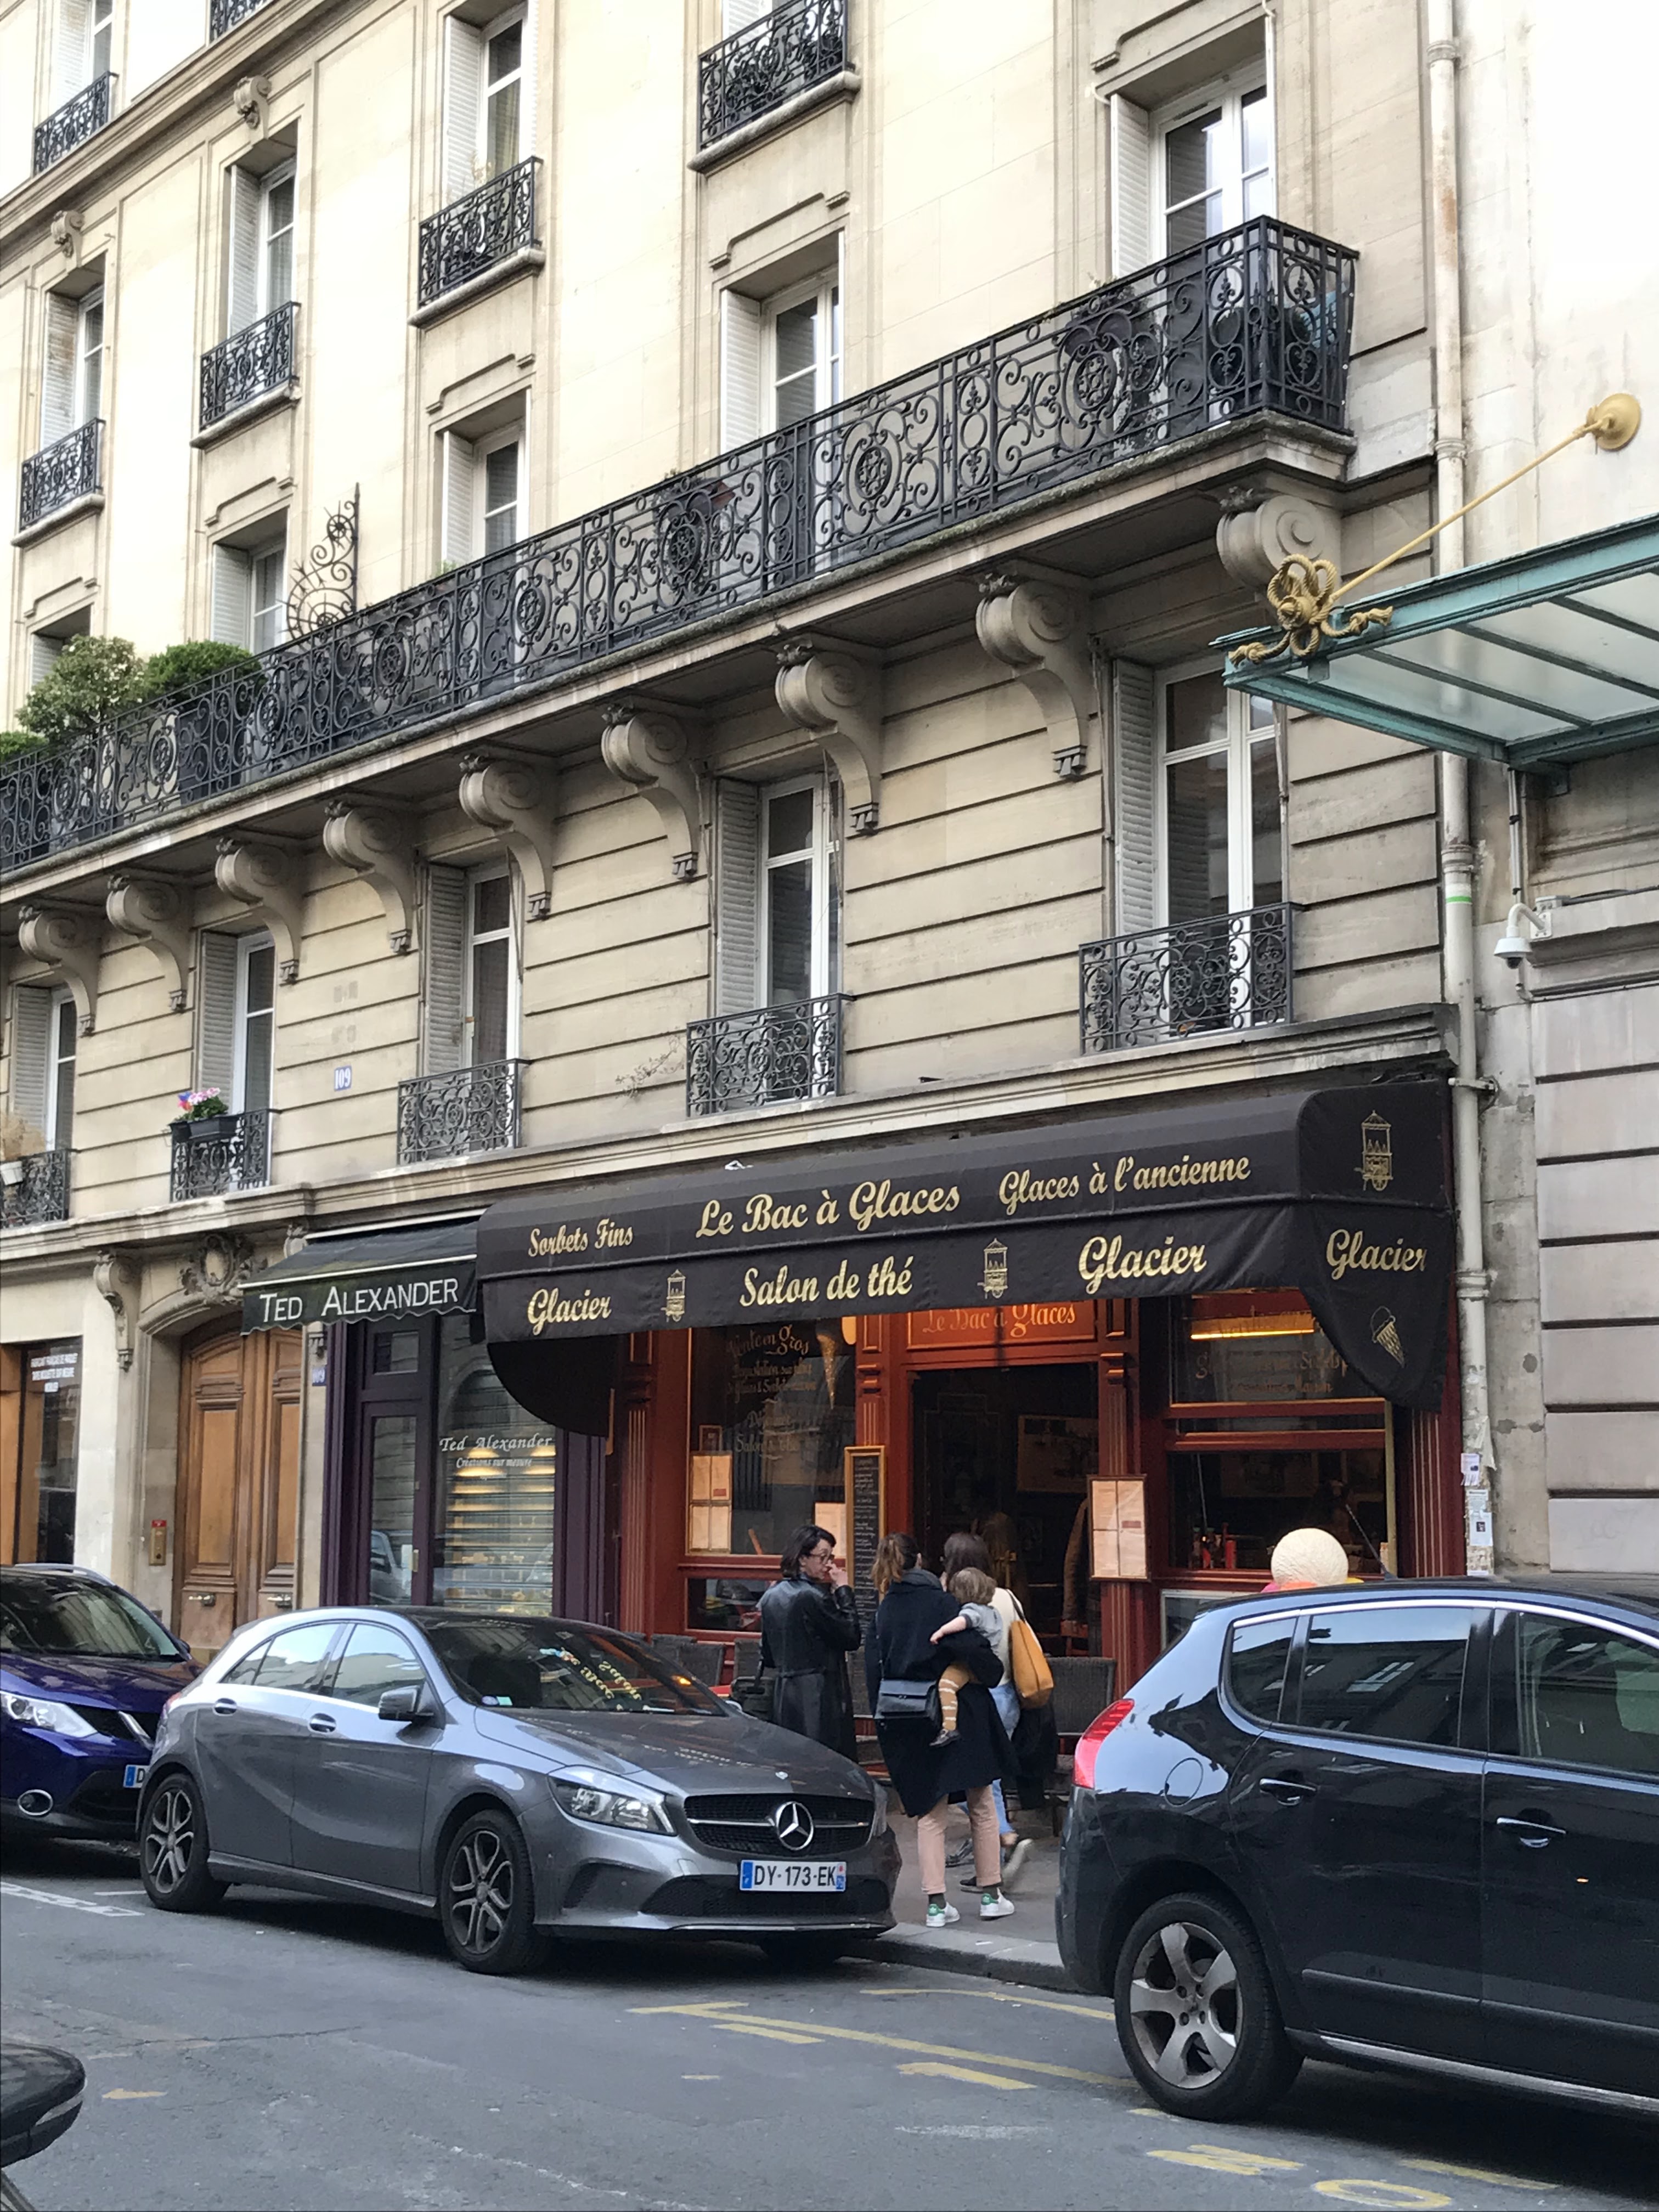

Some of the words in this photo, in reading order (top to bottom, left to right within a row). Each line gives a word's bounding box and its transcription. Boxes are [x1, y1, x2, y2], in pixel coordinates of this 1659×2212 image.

[335, 1068, 352, 1090] 109
[696, 1200, 734, 1238] Le
[742, 1194, 808, 1232] Bac
[816, 1189, 840, 1225] à
[849, 1179, 960, 1231] Glaces
[999, 1169, 1079, 1215] Glaces
[1089, 1162, 1108, 1194] à
[1114, 1155, 1251, 1192] l'ancienne
[528, 1224, 588, 1257] Sorbets
[594, 1218, 633, 1249] Fins
[1326, 1229, 1426, 1280] Glacier
[740, 1265, 820, 1306] Salon
[827, 1260, 860, 1300] de
[867, 1256, 913, 1297] thé
[1079, 1235, 1207, 1294] Glacier
[259, 1293, 302, 1323] TED
[321, 1278, 459, 1317] ALEXANDER
[527, 1288, 612, 1335] Glacier
[439, 1435, 469, 1452] Ted
[475, 1432, 552, 1452] Alexander
